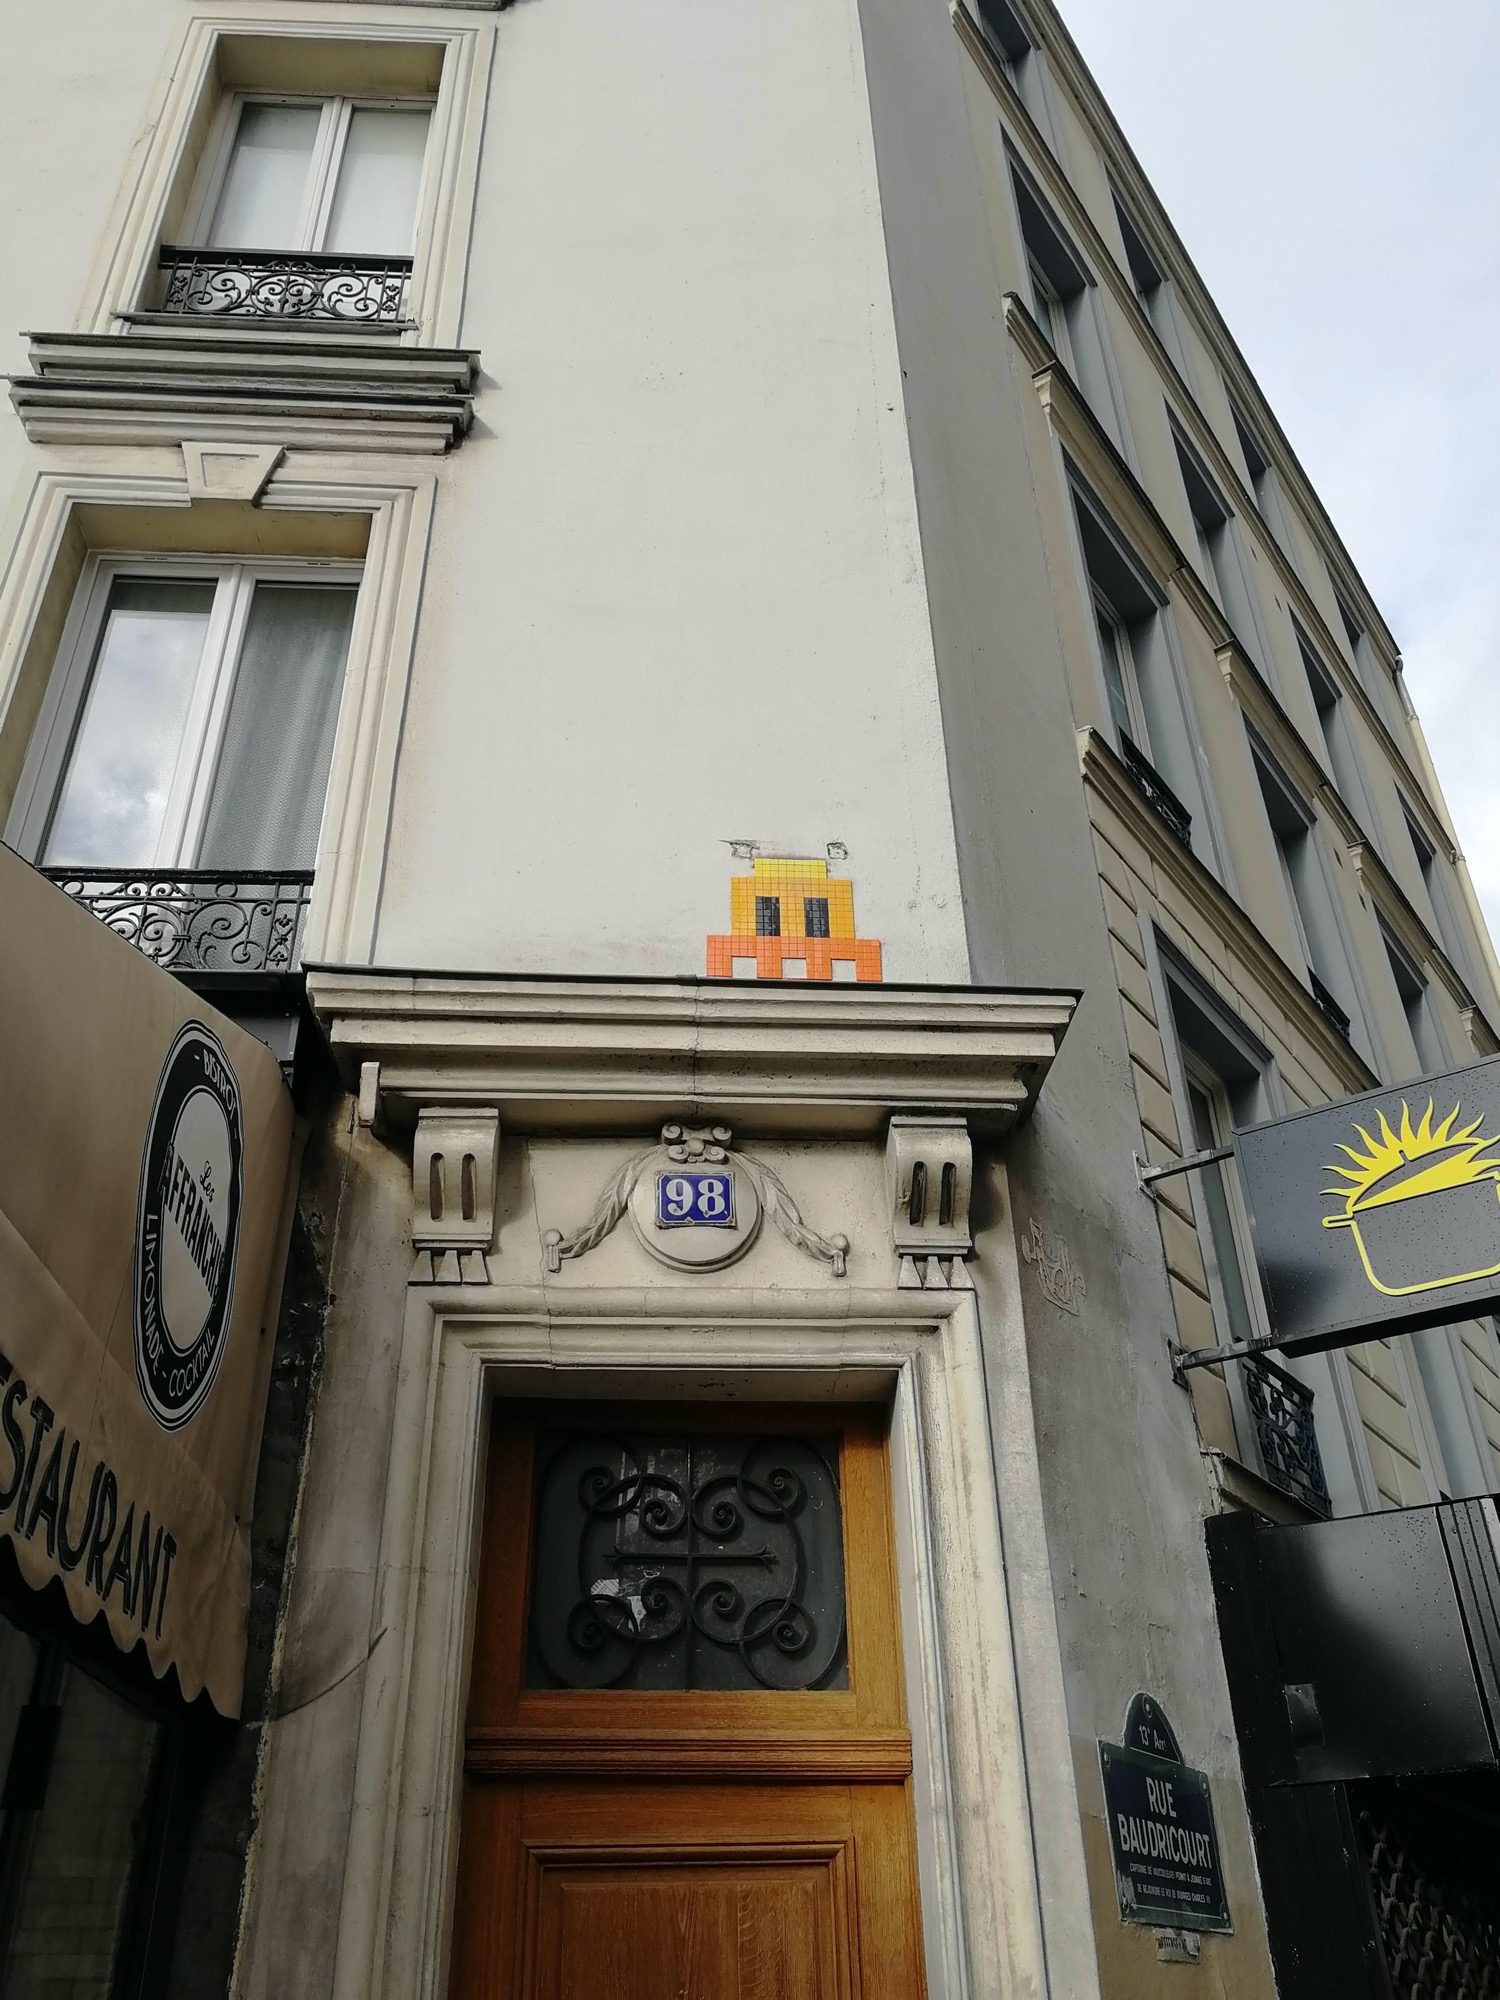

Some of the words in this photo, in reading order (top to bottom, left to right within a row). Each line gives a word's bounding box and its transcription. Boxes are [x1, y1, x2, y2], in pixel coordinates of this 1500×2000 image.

[203, 1048, 237, 1120] BISTROT
[200, 1160, 215, 1203] Les
[665, 1178, 726, 1217] 98
[144, 1213, 165, 1376] LIMONADE
[169, 1328, 215, 1397] COCKTAIL
[0, 1353, 177, 1641] STAURANT
[1146, 1776, 1177, 1818] RUE
[1117, 1813, 1212, 1869] BAUDRICOURT
